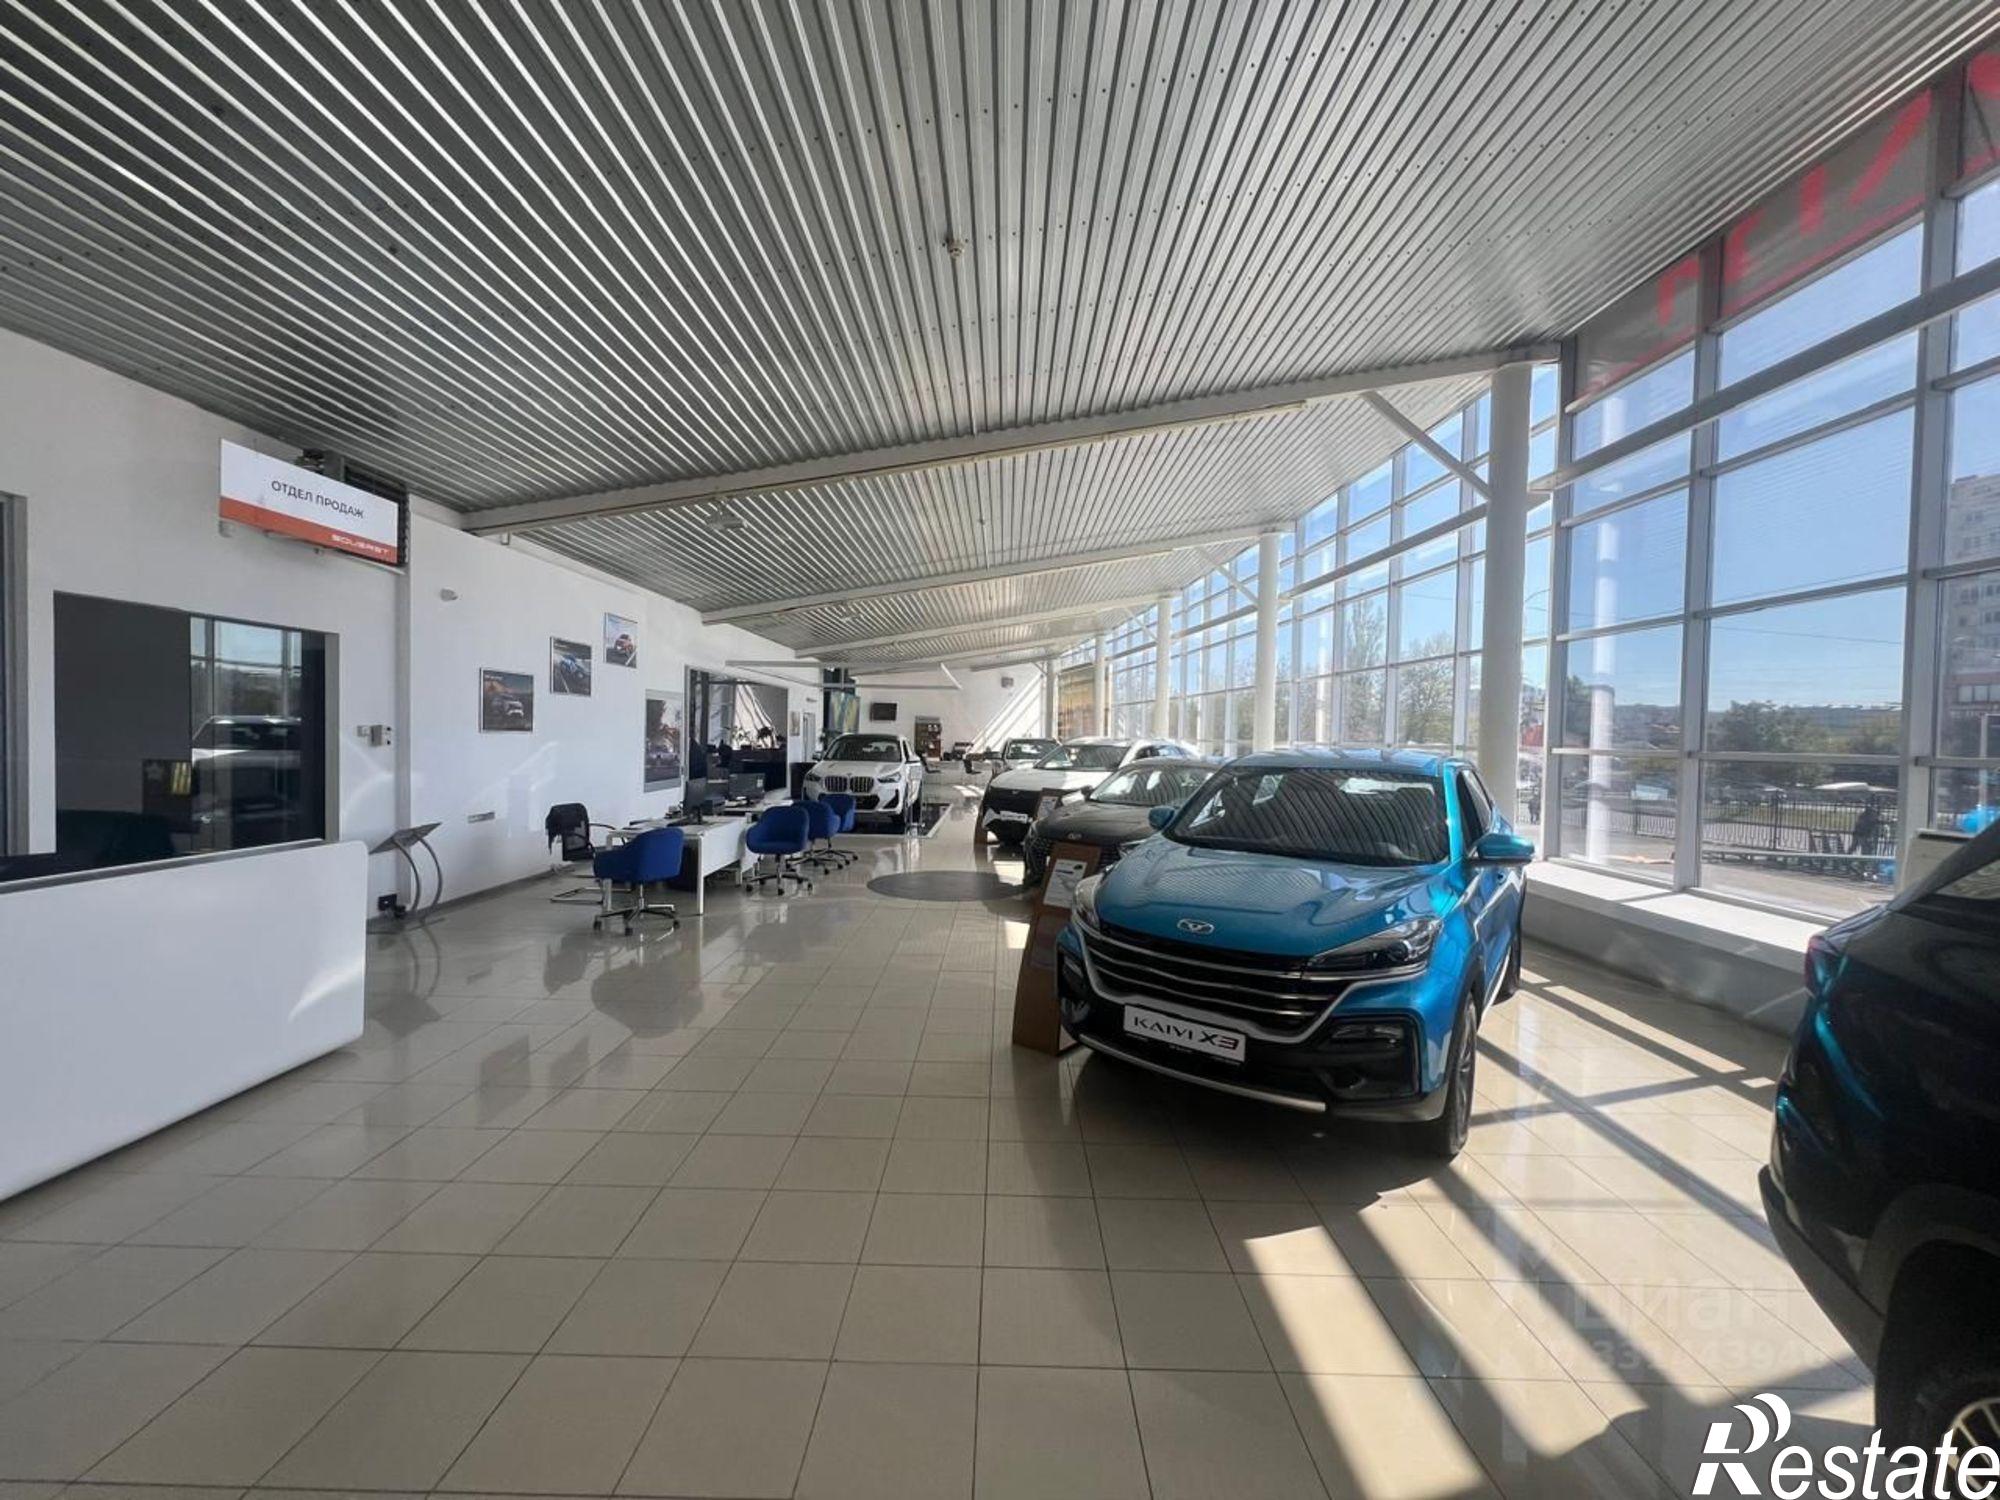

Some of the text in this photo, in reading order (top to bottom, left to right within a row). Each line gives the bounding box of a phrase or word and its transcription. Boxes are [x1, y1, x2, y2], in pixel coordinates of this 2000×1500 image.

[271, 480, 364, 518] ОТДЕЛ ПРОДАЖ
[1199, 1031, 1239, 1050] X3
